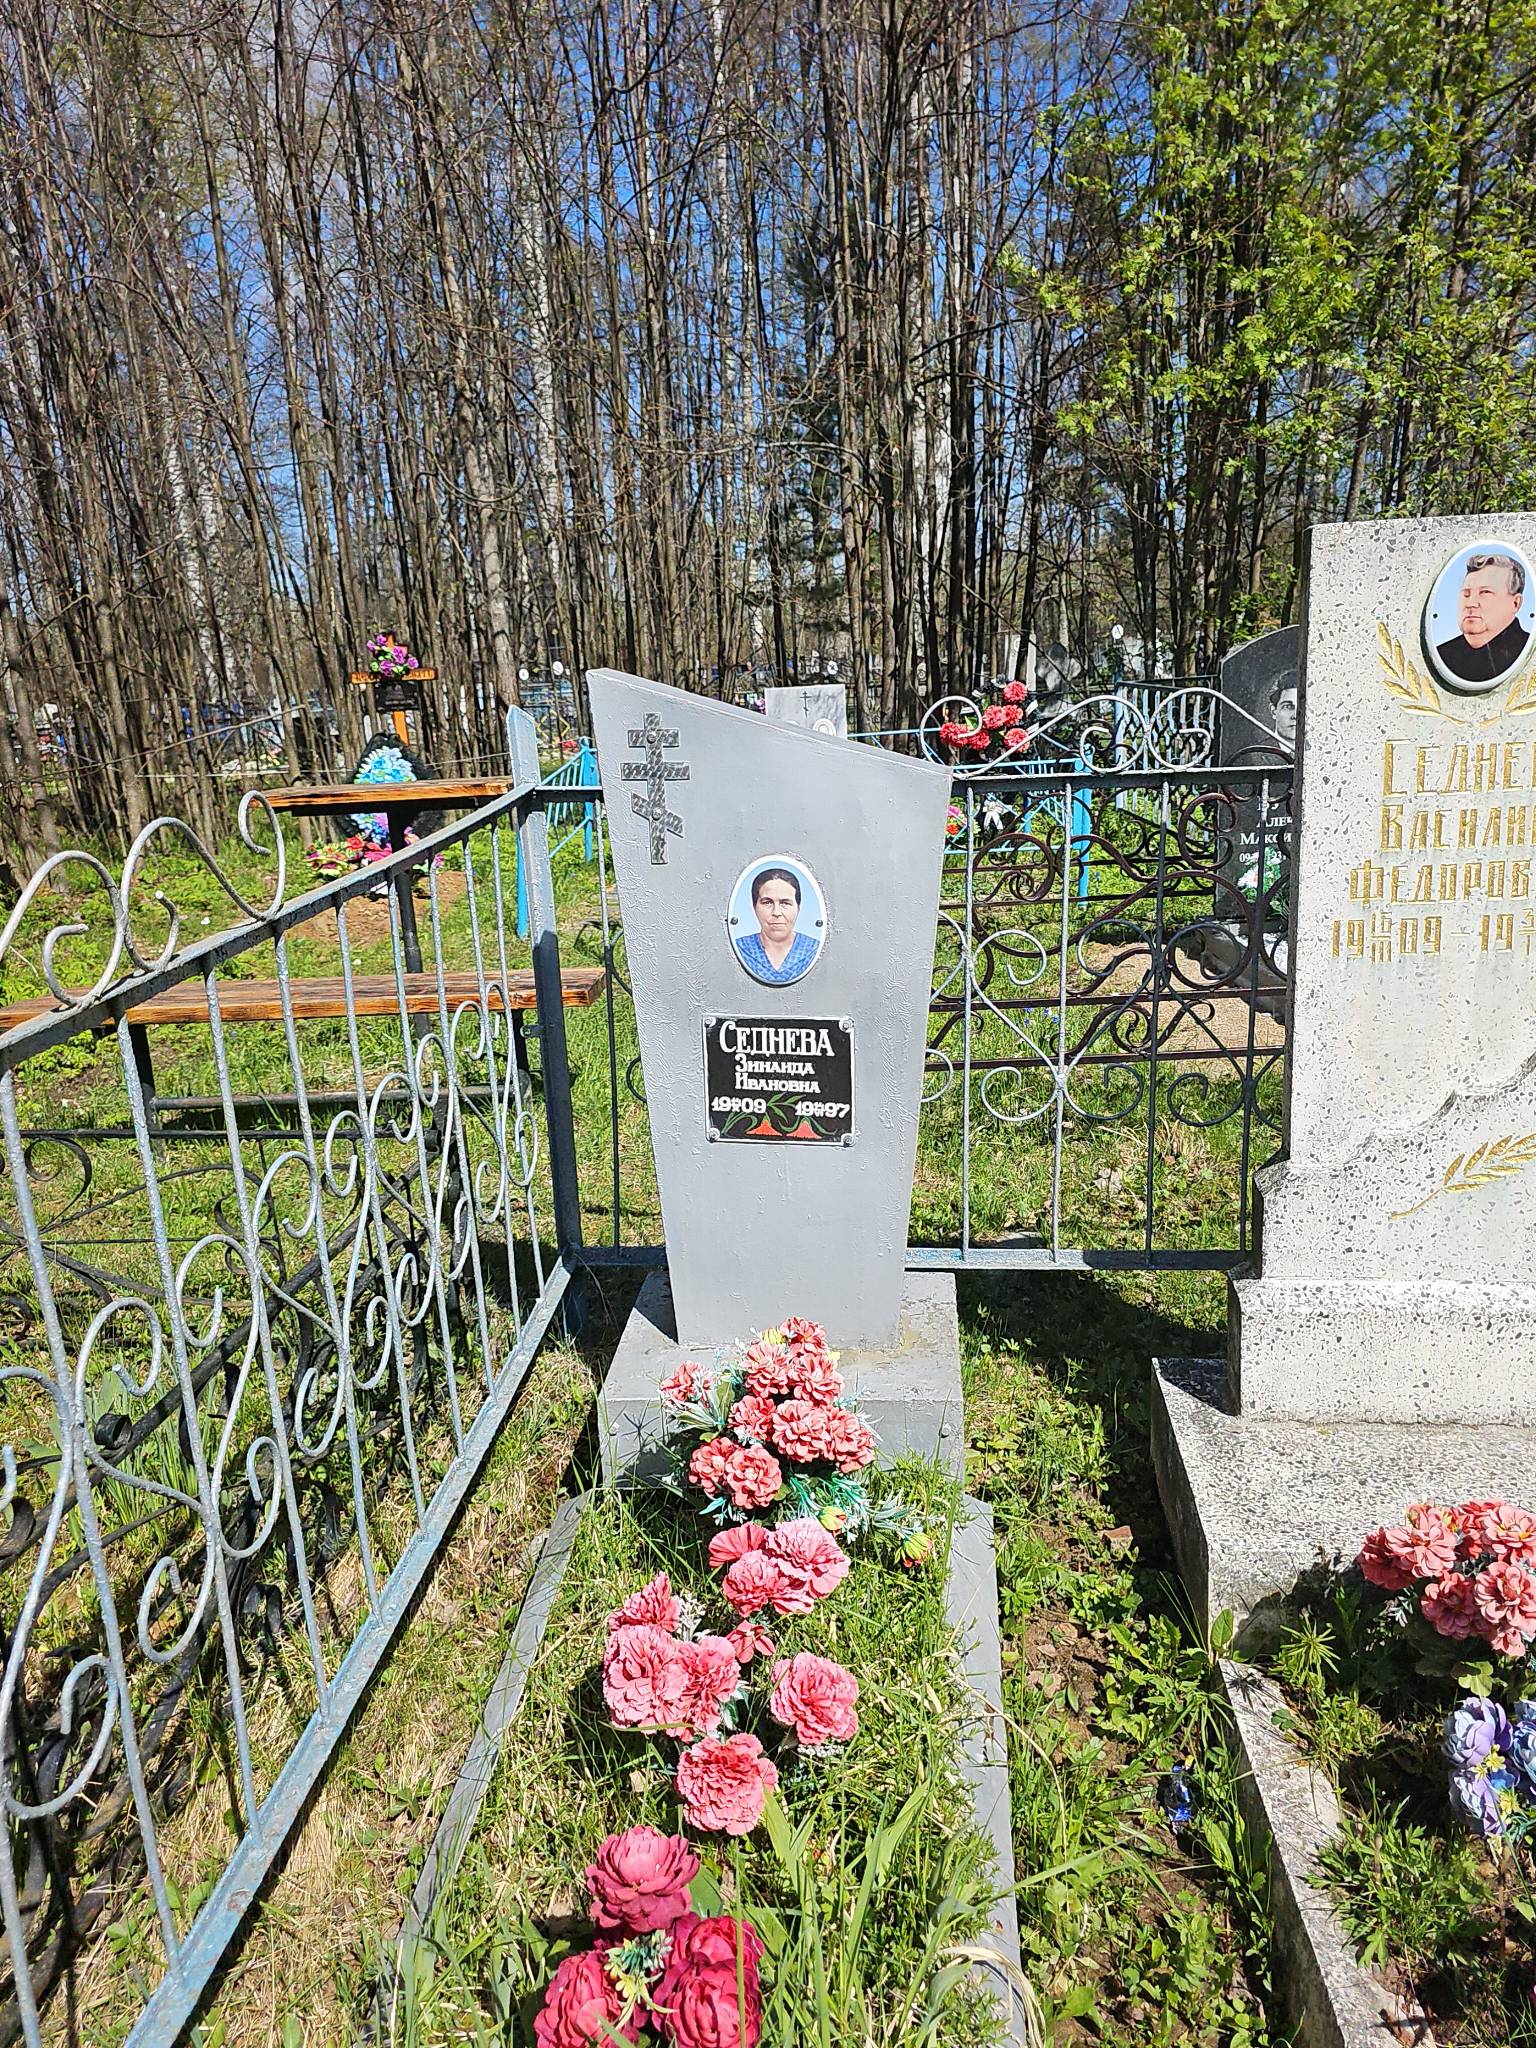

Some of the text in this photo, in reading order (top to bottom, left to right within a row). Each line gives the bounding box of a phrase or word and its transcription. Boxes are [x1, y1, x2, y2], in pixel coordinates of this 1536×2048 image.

[719, 1020, 835, 1057] СЕДНЕВА
[734, 1053, 815, 1076] ЗИНАИДА
[734, 1072, 821, 1094] ИВАНОВНА
